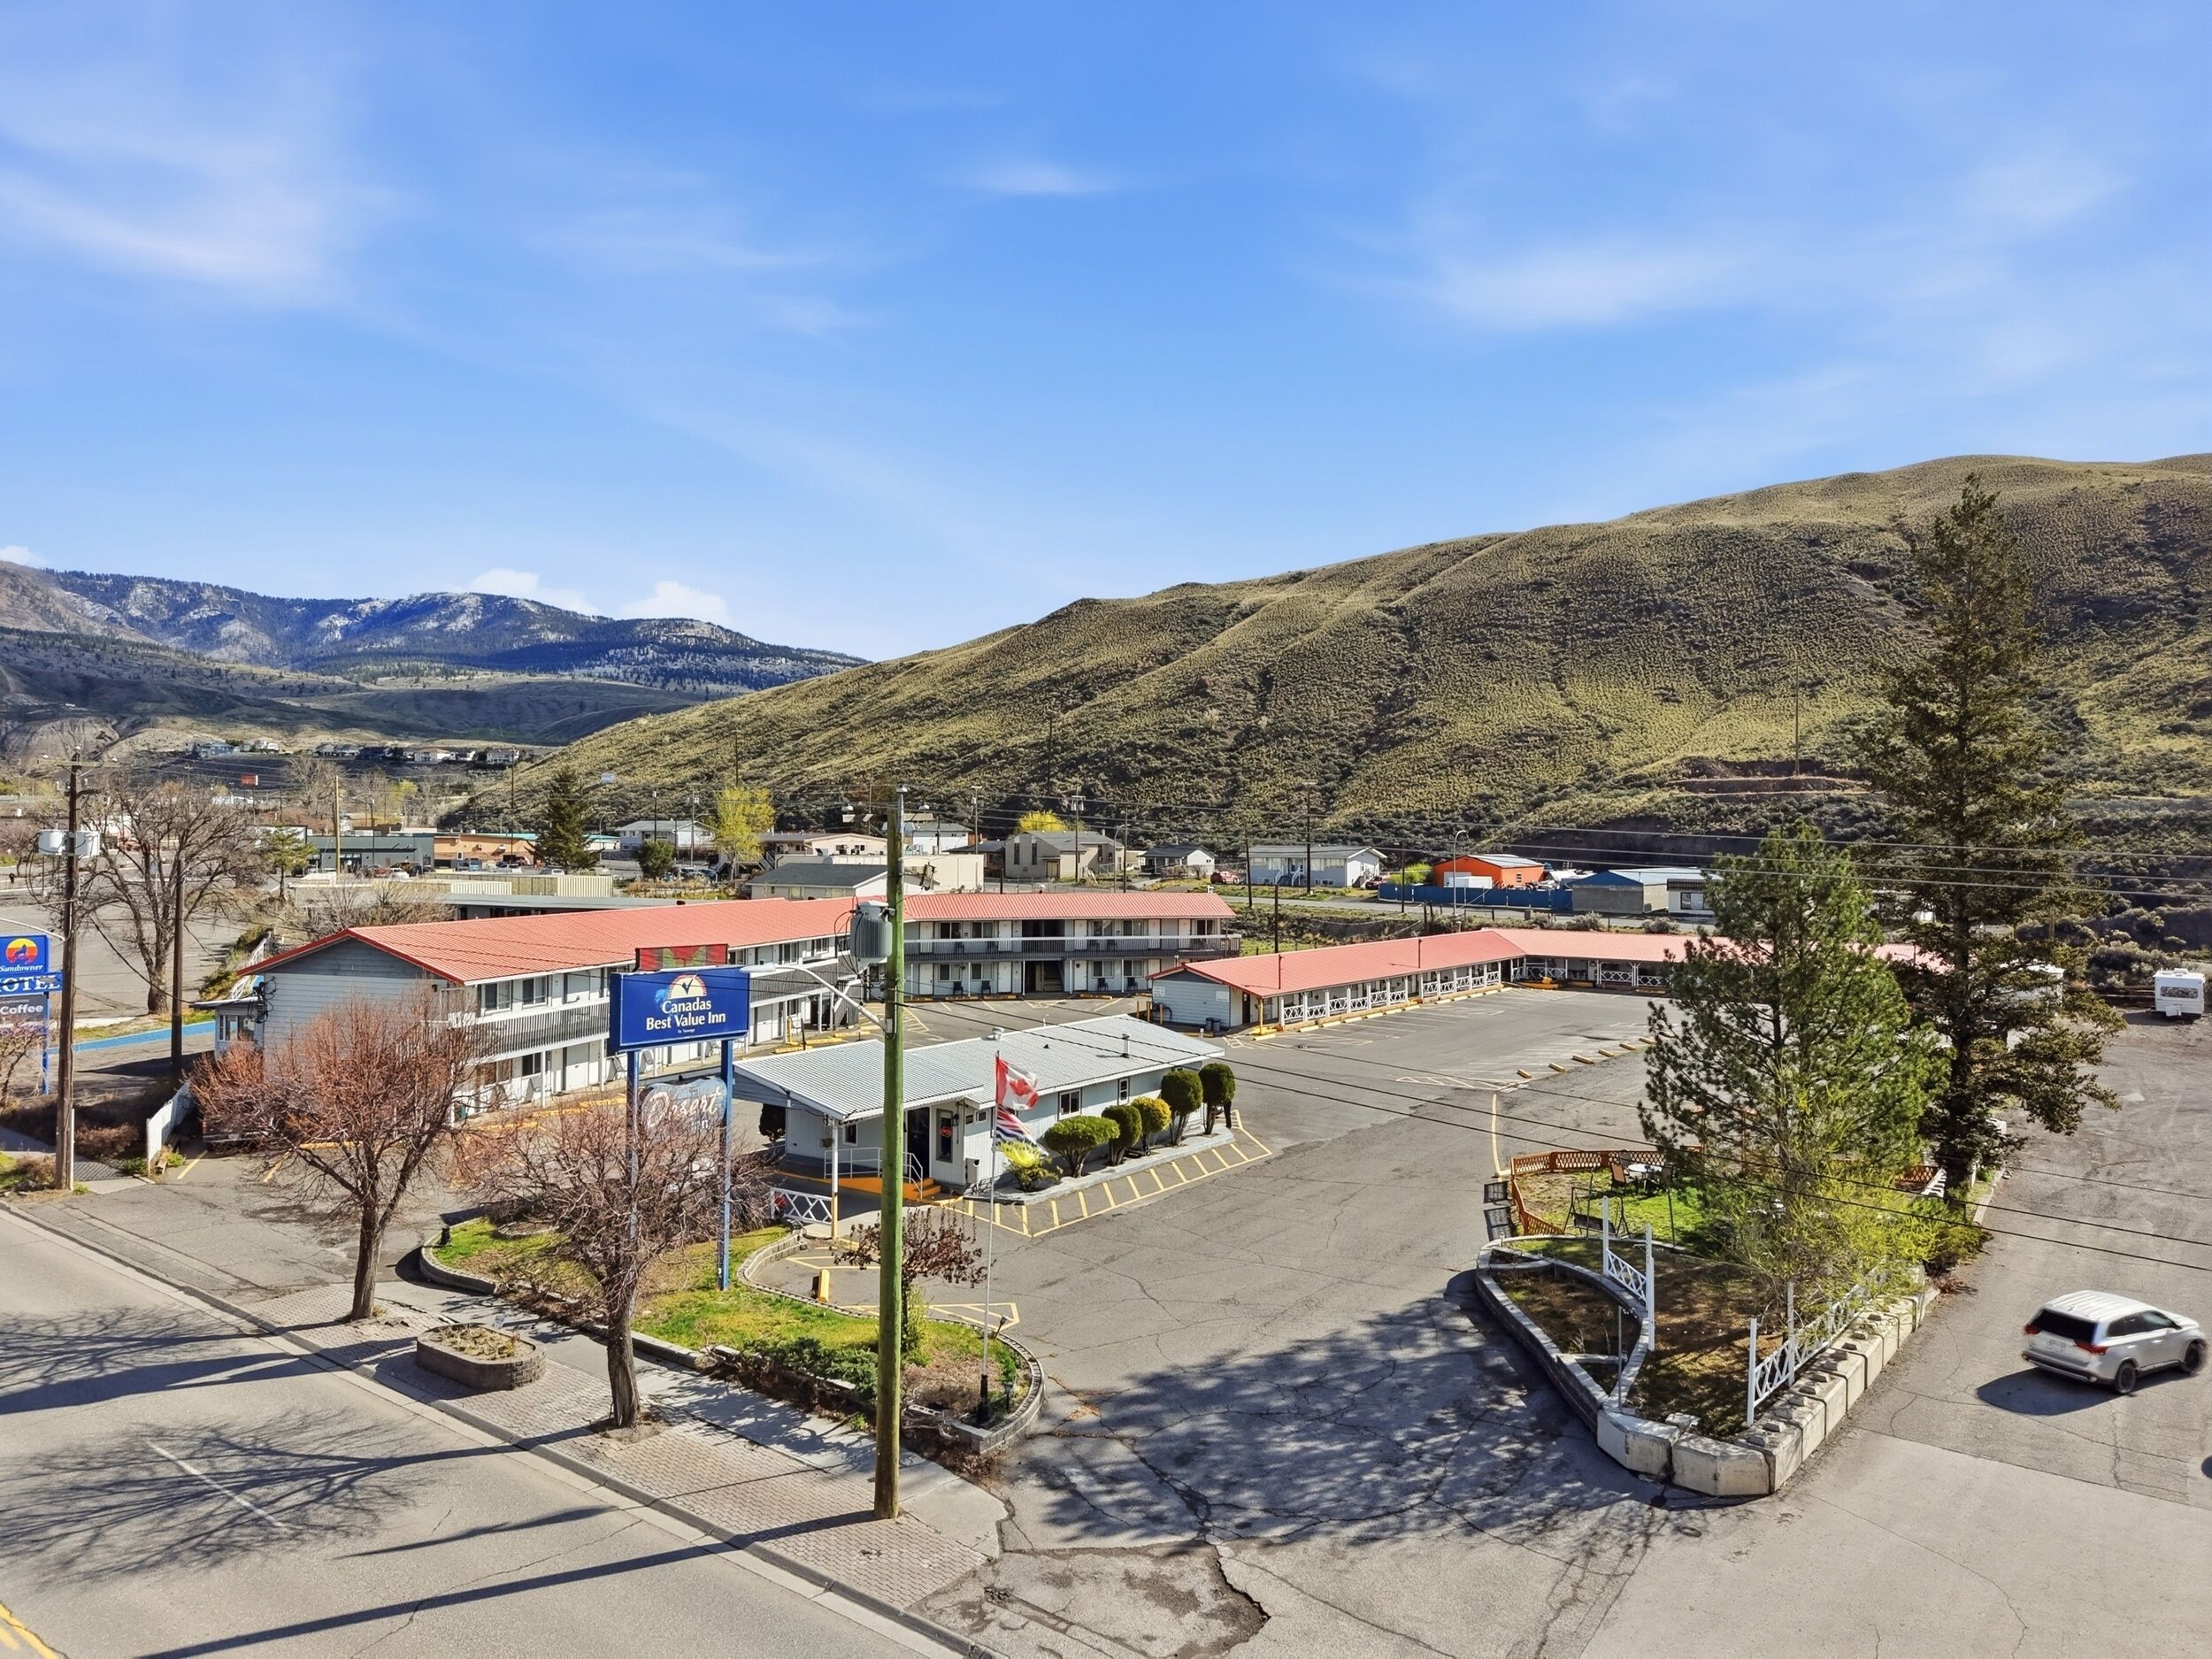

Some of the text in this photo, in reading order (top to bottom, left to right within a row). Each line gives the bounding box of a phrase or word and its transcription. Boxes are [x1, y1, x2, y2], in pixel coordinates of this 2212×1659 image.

[0, 975, 60, 993] OTEL
[0, 1003, 43, 1016] Coffee
[662, 996, 712, 1014] Canadas
[647, 1010, 726, 1031] Best Value Inn
